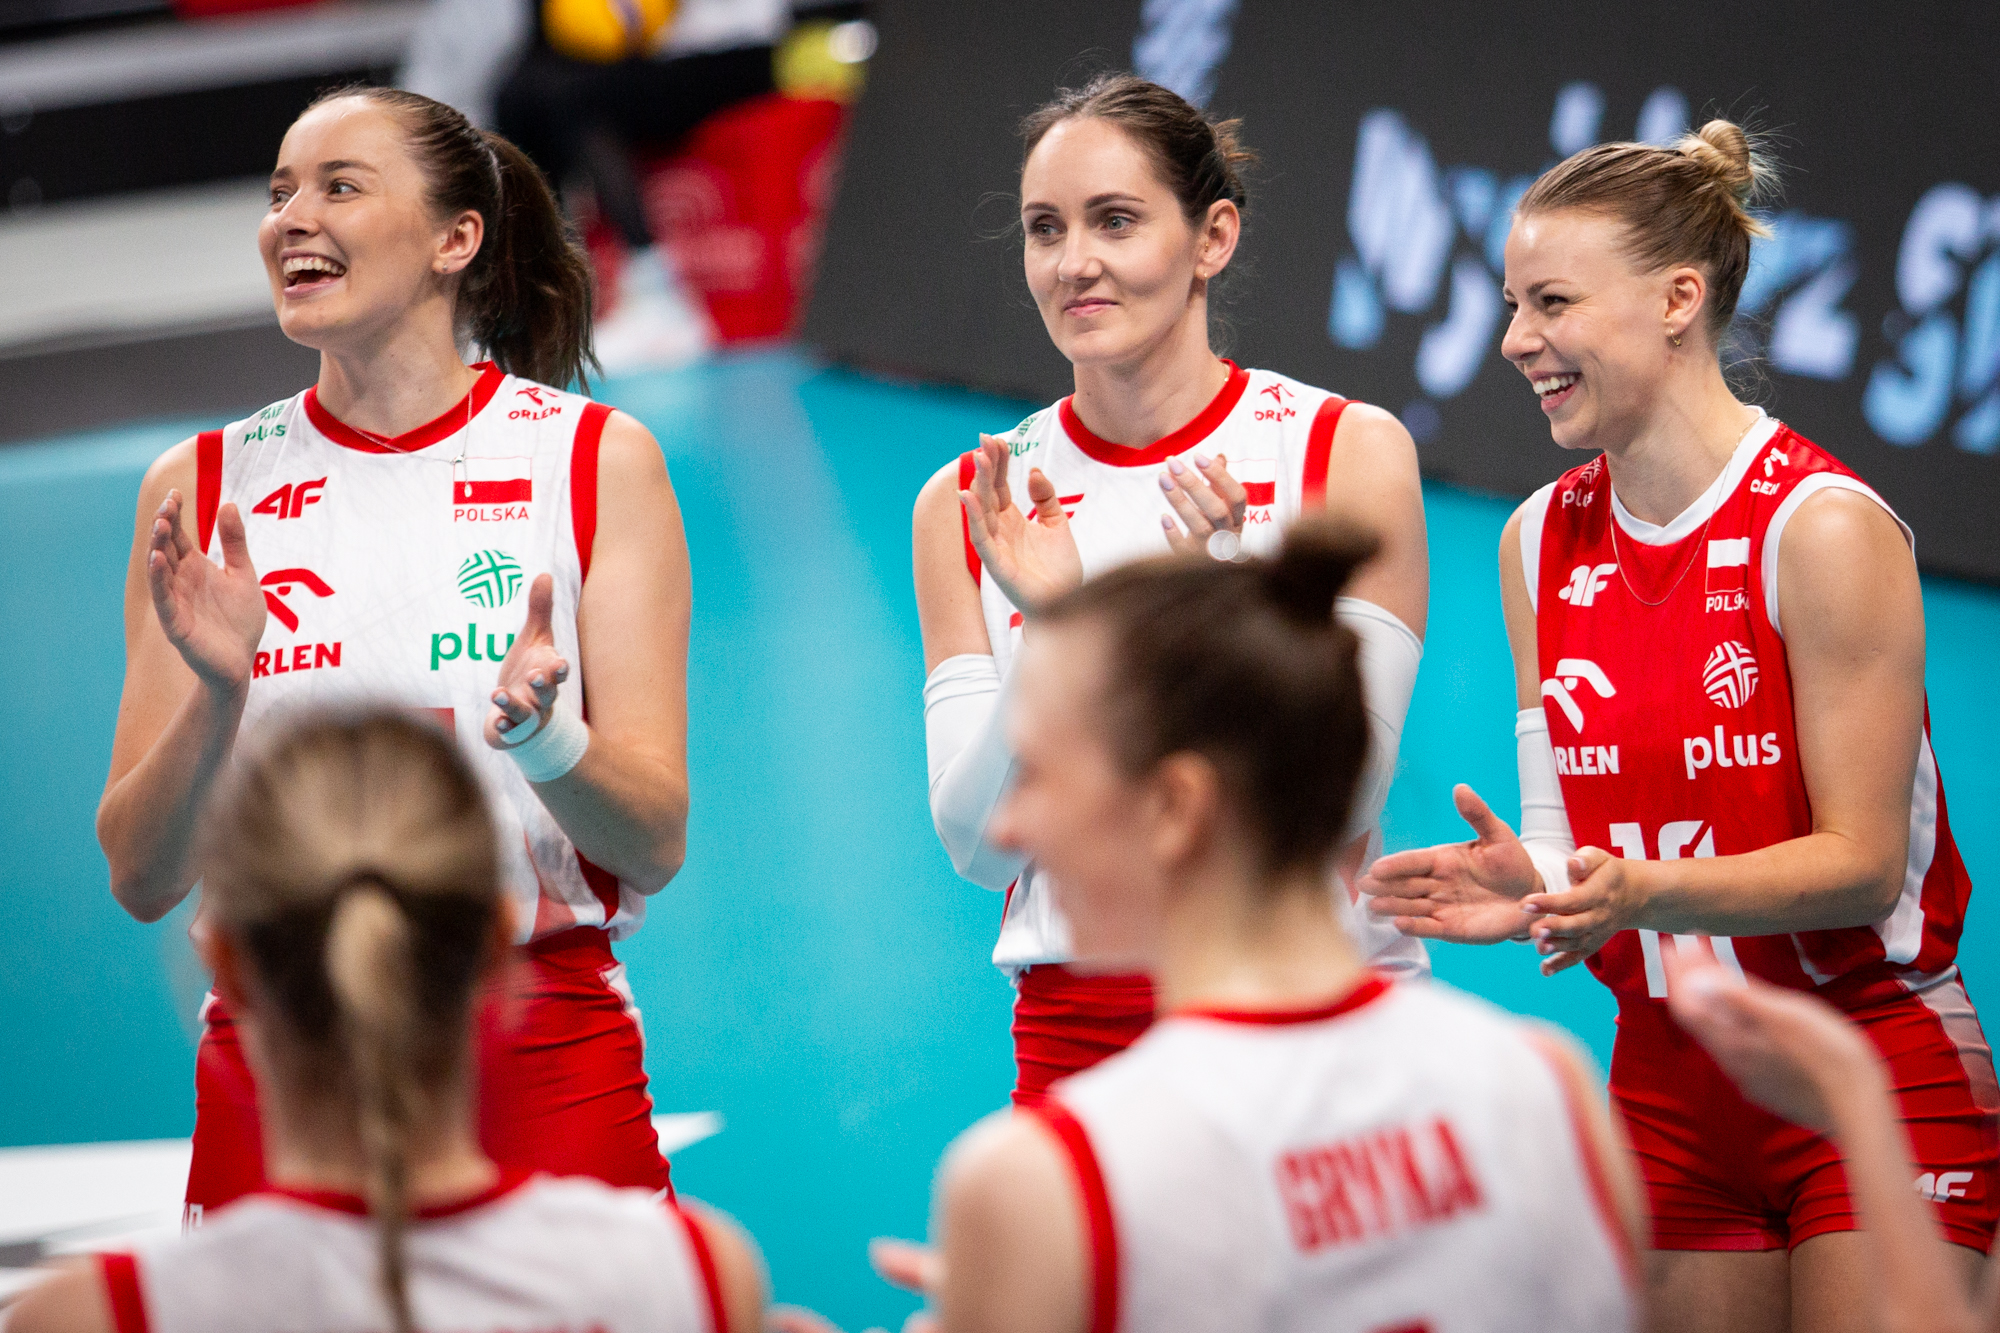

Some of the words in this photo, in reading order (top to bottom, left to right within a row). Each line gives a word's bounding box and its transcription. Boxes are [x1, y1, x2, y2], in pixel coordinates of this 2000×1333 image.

[507, 406, 563, 421] ORLEN
[1254, 406, 1296, 422] ORLN
[252, 476, 328, 520] 4F
[453, 506, 530, 523] POLSKA
[1558, 563, 1618, 607] 4F
[252, 641, 342, 680] RLEN
[430, 622, 515, 671] plu
[1553, 744, 1620, 775] RLEN
[1684, 725, 1782, 780] plus
